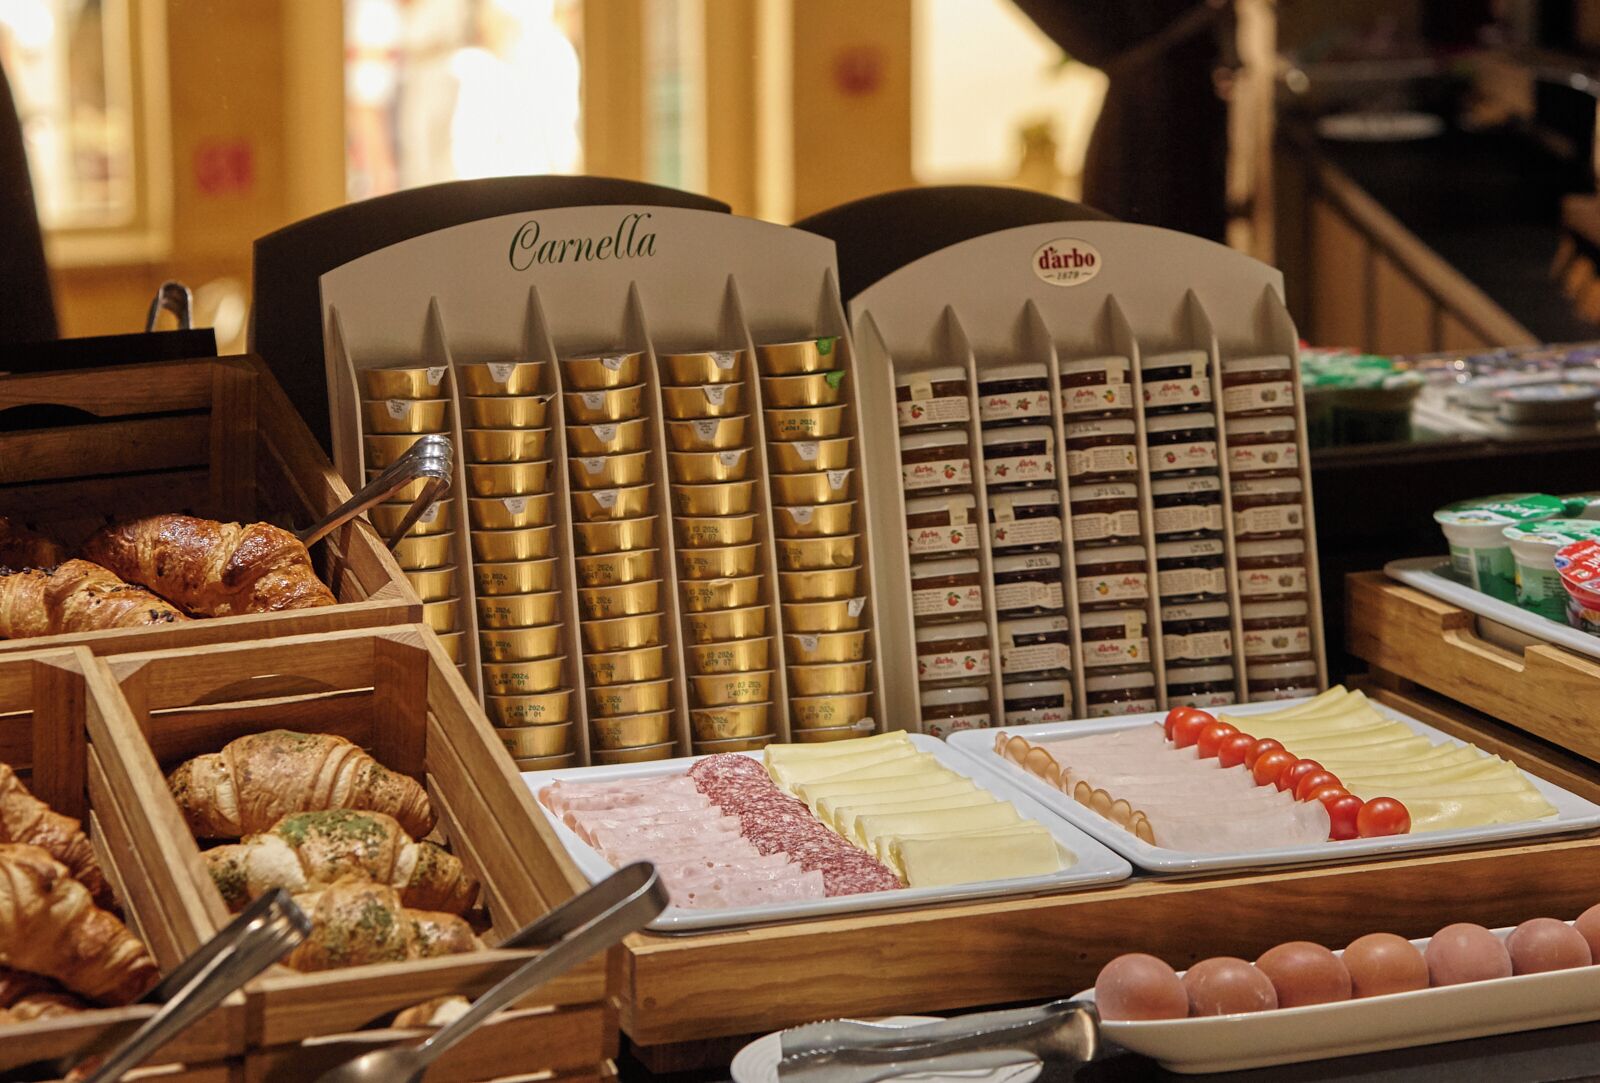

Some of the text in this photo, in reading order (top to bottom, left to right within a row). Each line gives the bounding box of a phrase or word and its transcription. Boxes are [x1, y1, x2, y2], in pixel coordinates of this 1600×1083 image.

[509, 213, 656, 271] Carnella
[511, 672, 529, 680] 2026
[528, 704, 546, 712] 2026
